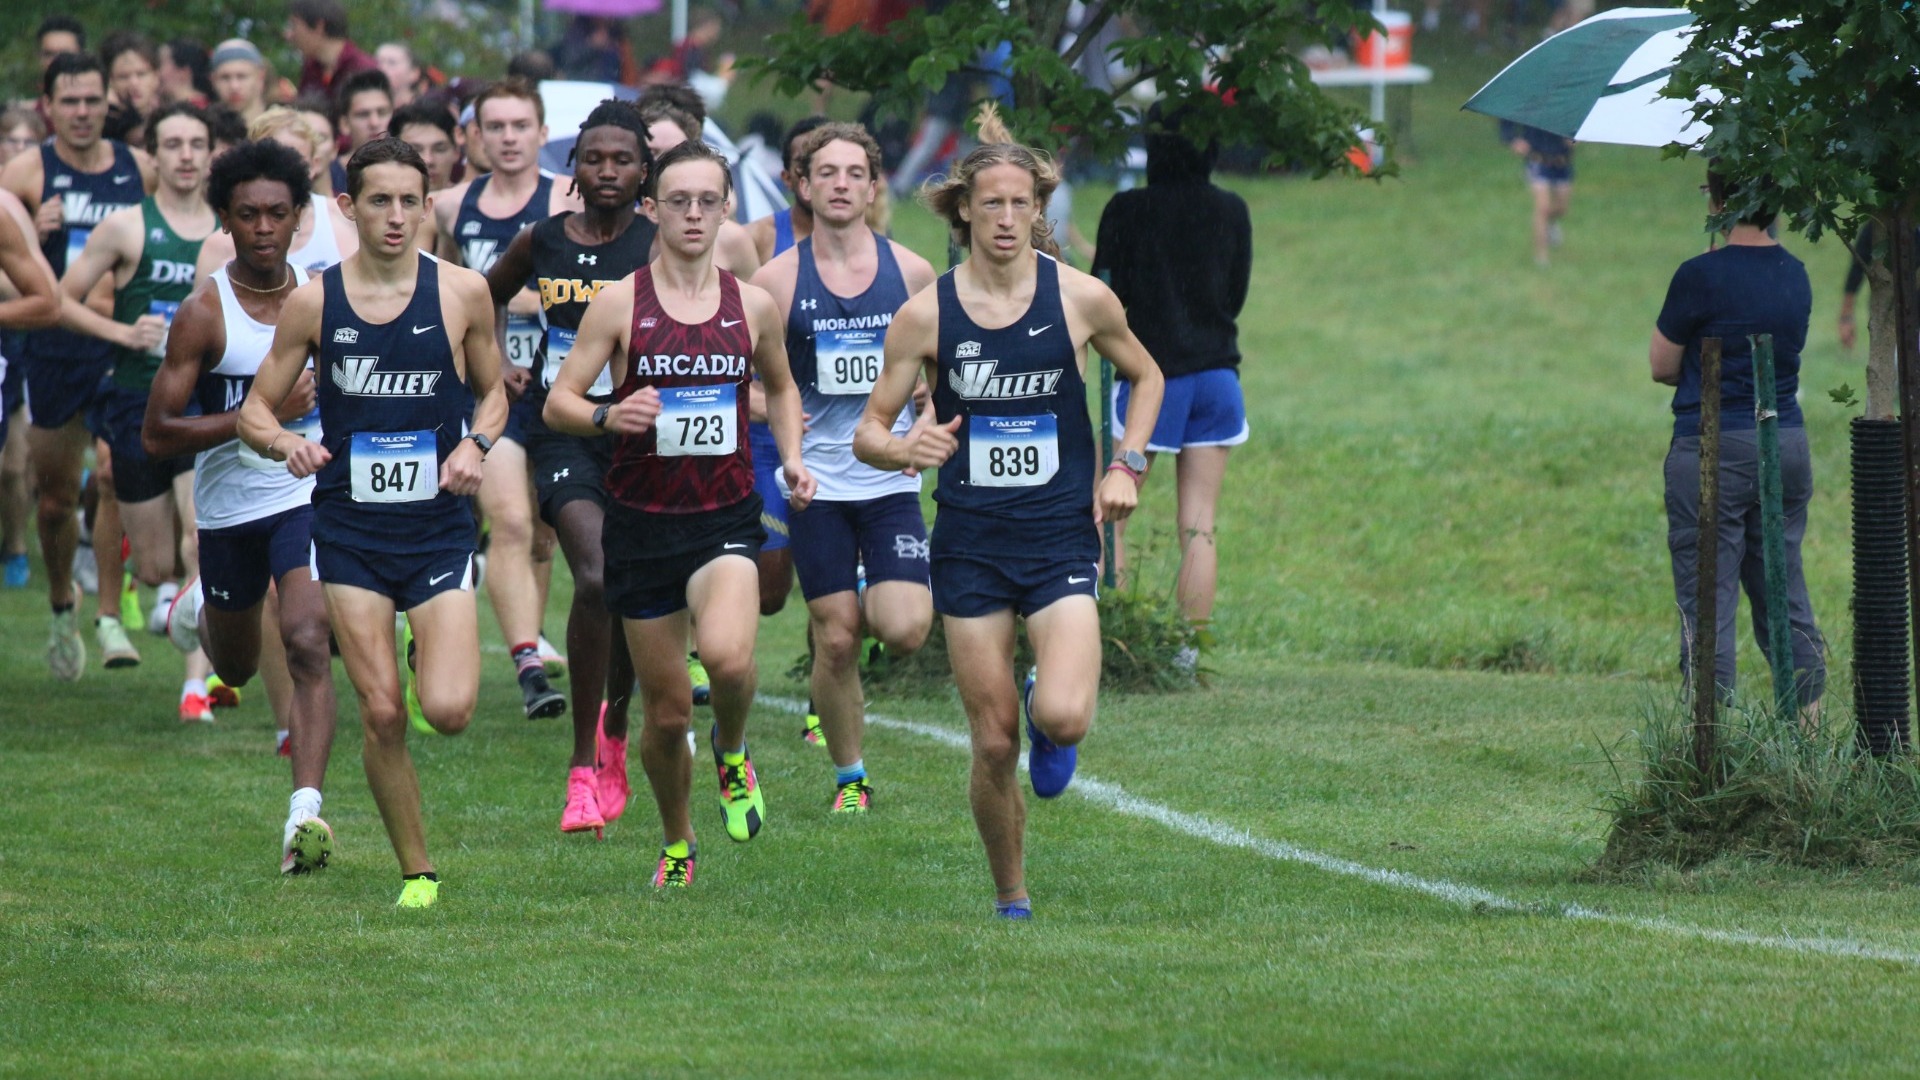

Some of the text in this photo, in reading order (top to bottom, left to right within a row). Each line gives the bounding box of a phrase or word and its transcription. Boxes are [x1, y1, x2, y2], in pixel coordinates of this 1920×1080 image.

[64, 192, 136, 223] VAL
[150, 260, 196, 284] DR
[538, 277, 621, 311] BOW
[813, 313, 893, 332] MORAVIAN
[335, 334, 357, 343] MAC
[508, 335, 535, 360] 31
[559, 331, 578, 340] FAL
[834, 332, 877, 340] FALCON
[958, 347, 979, 356] MAC
[343, 356, 440, 396] VALLEY
[636, 354, 746, 377] ARCADIA
[834, 355, 878, 384] 906
[961, 361, 1061, 399] VALLEY
[675, 388, 721, 398] FALCON
[676, 414, 724, 447] 723
[989, 419, 1037, 428] FALCON
[371, 435, 418, 443] FALCON
[989, 445, 1039, 477] 839
[370, 461, 419, 493] 847
